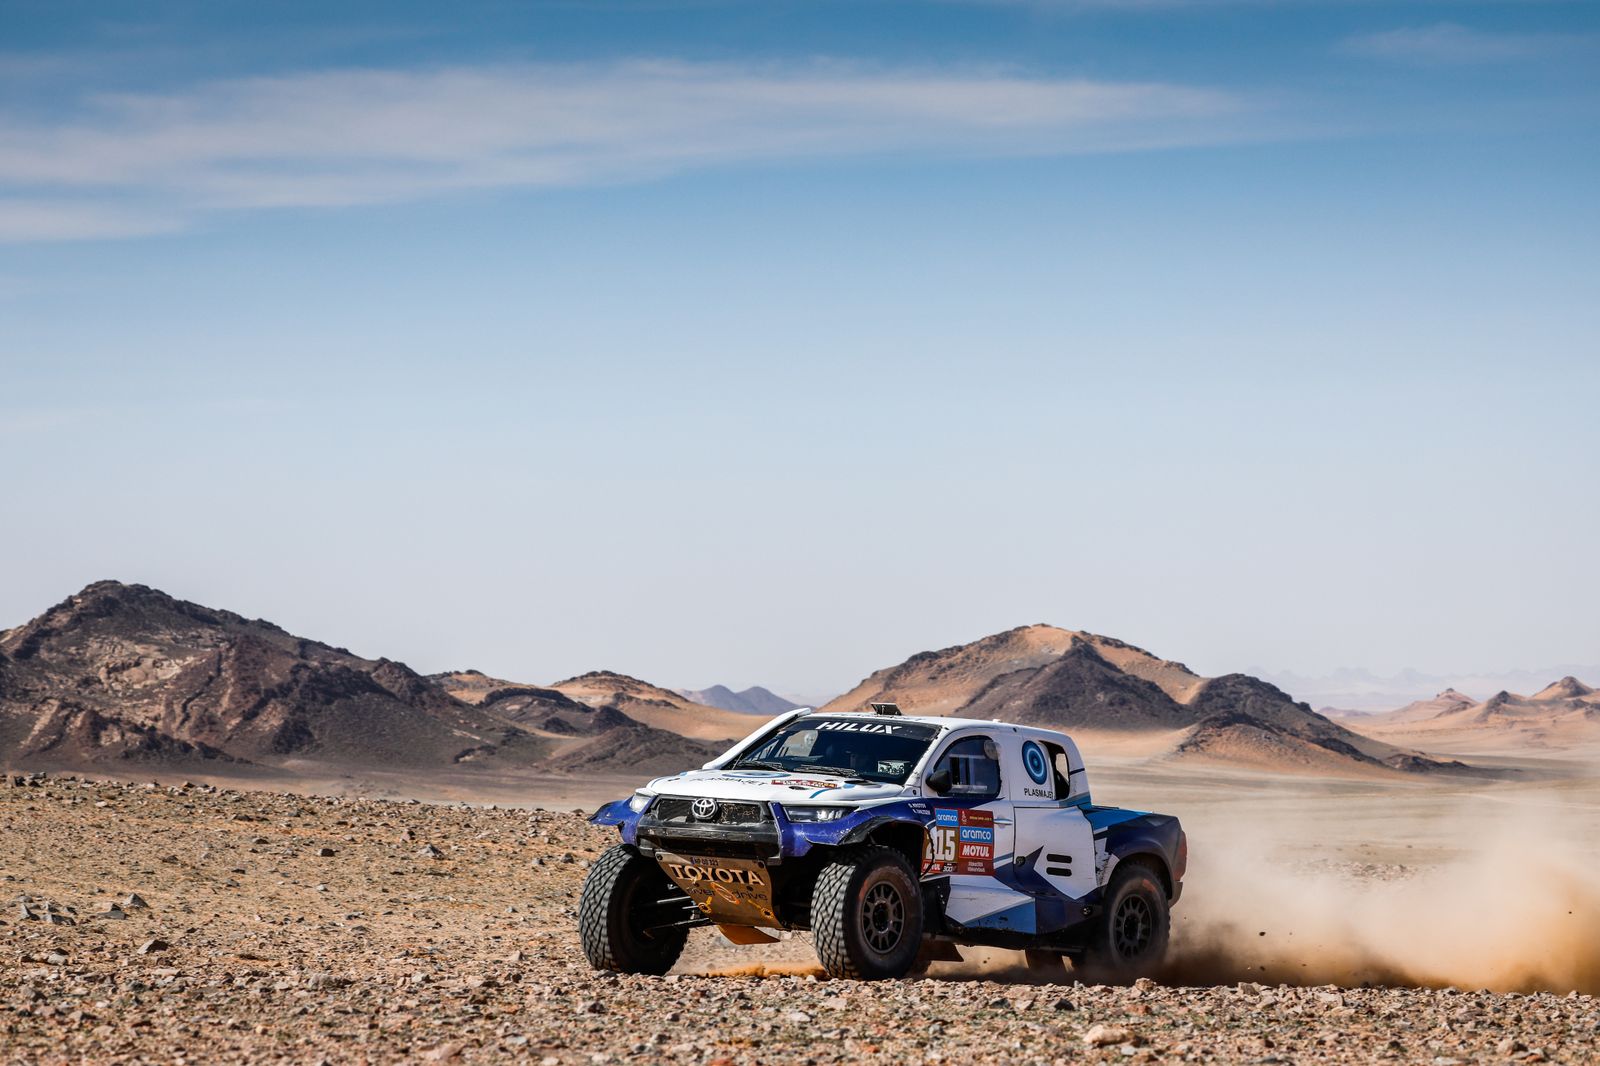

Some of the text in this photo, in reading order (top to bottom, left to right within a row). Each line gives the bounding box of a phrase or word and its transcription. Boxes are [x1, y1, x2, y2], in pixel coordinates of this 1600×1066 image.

[815, 721, 903, 735] HILUX
[937, 813, 957, 822] aramco
[961, 829, 992, 841] aramco
[962, 844, 990, 857] MOTUL
[668, 863, 765, 886] TOYOTA
